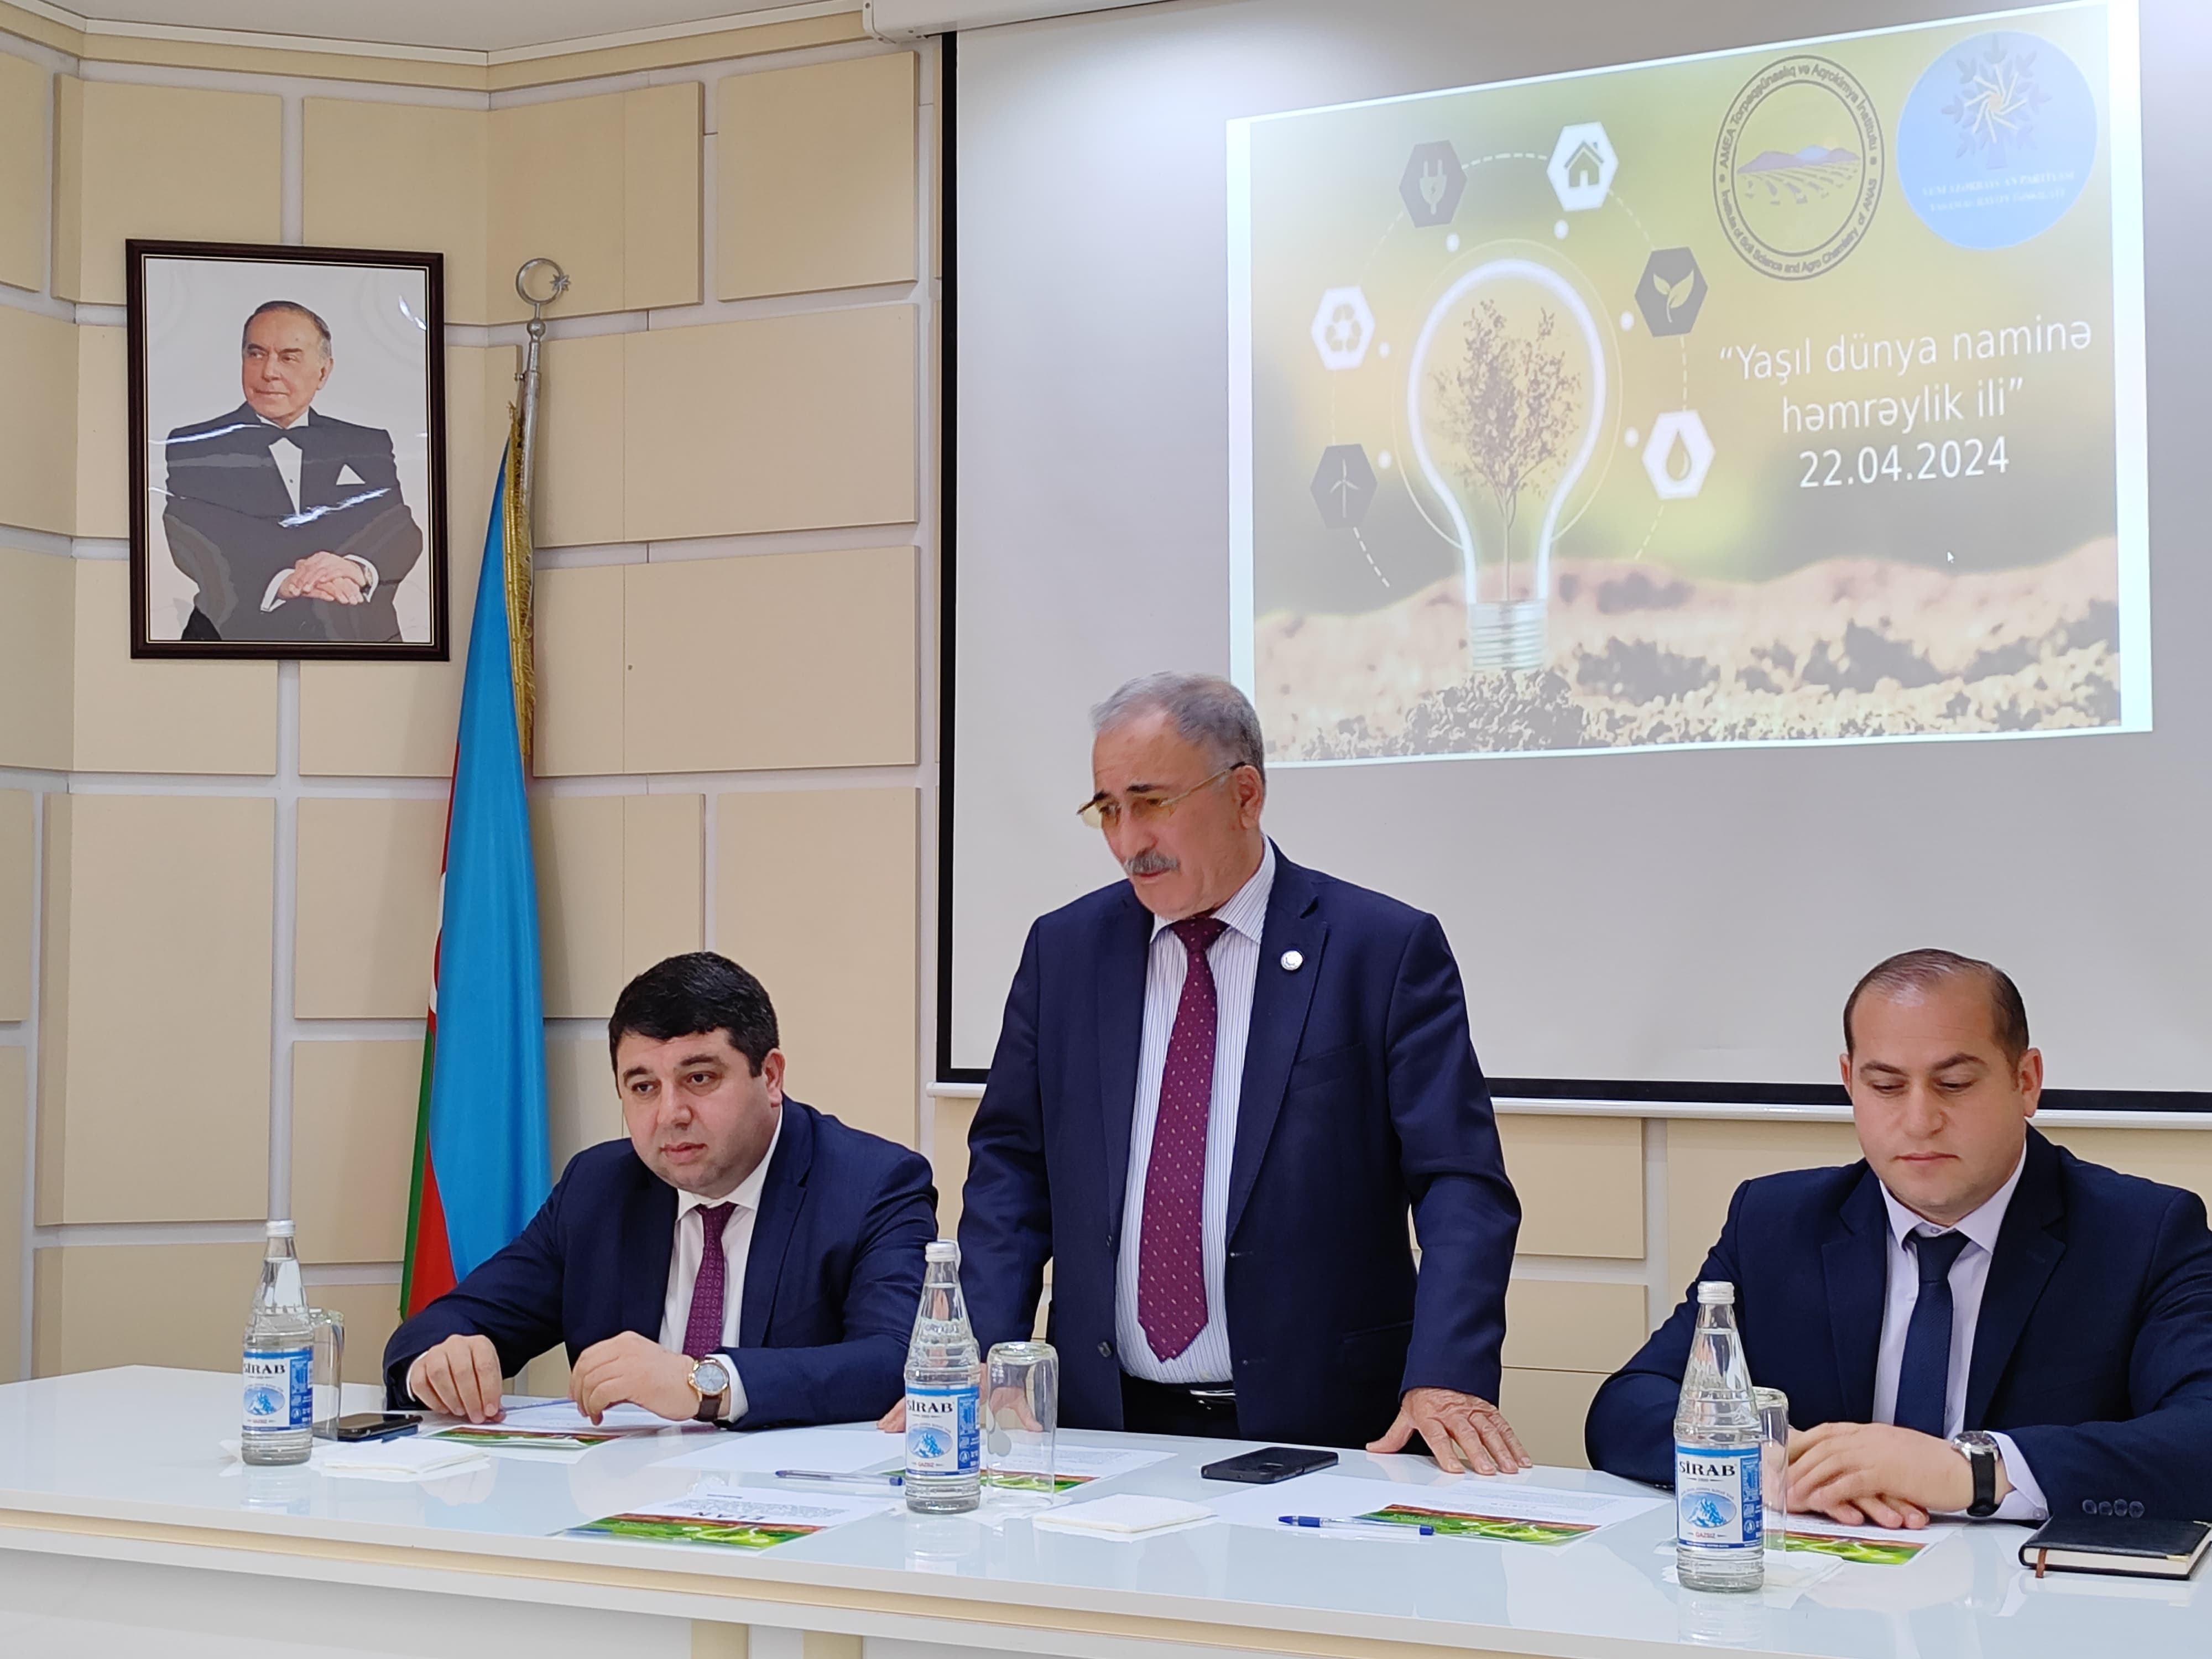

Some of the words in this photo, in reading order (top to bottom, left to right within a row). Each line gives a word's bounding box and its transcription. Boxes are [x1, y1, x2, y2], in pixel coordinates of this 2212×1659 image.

[1720, 128, 1736, 169] AMEA
[1797, 65, 1810, 75] və
[1785, 262, 1800, 273] and
[1863, 178, 1877, 211] ANAS
[1826, 333, 1936, 376] dünya
[1953, 314, 2091, 362] naminə
[1782, 382, 1964, 434] həmrəylik
[1799, 435, 2010, 488] 22.04.2024
